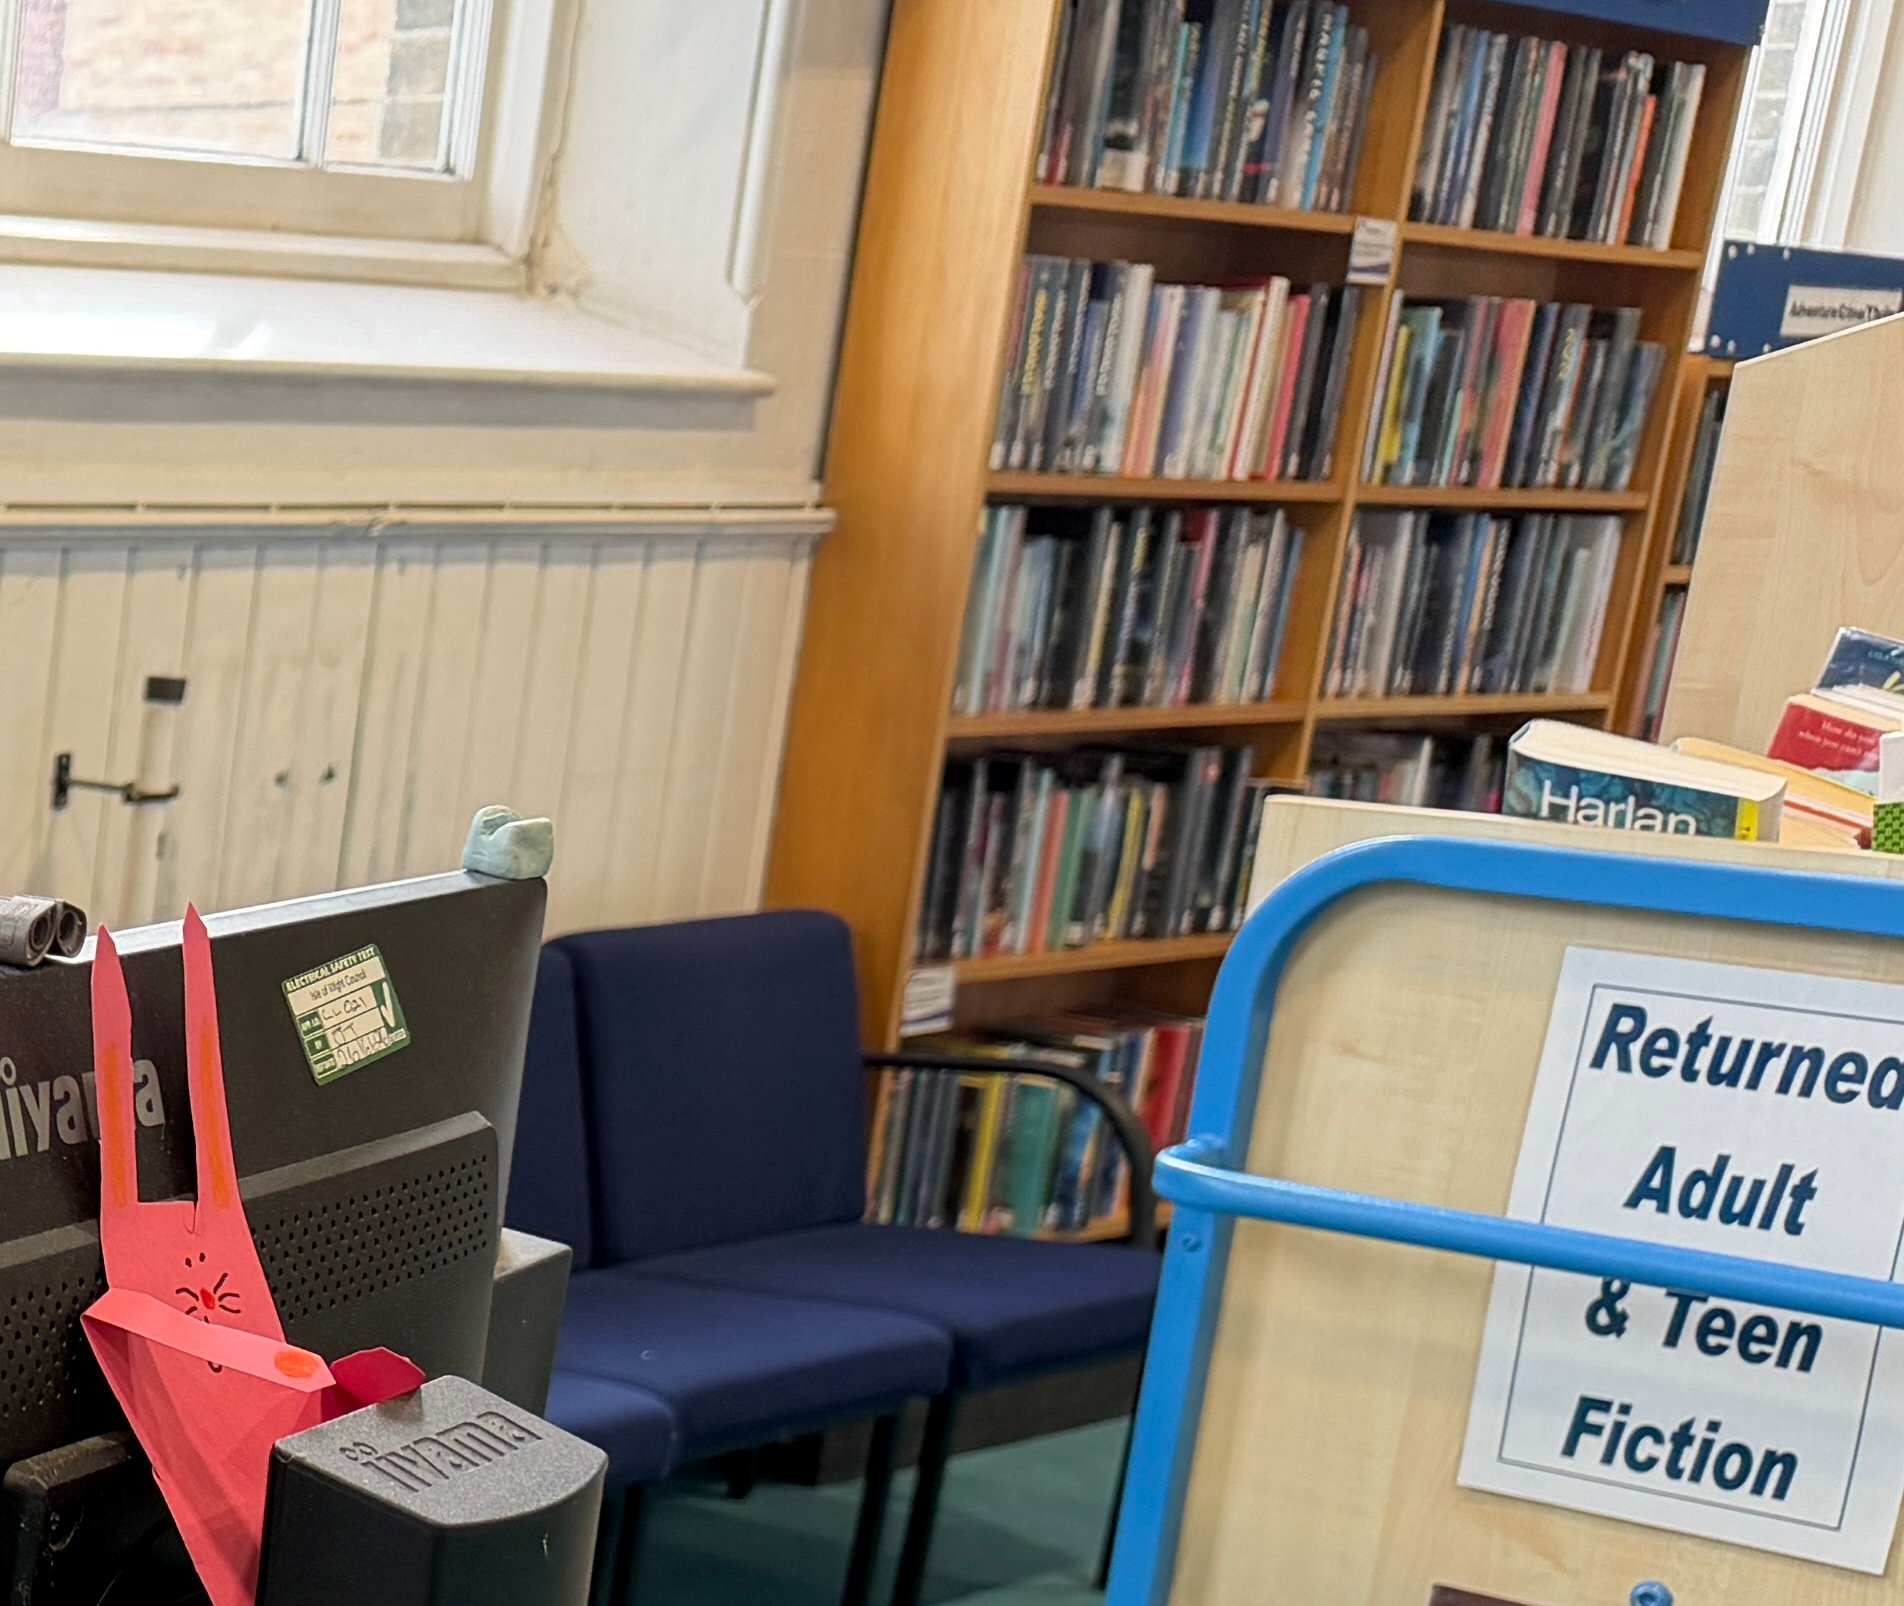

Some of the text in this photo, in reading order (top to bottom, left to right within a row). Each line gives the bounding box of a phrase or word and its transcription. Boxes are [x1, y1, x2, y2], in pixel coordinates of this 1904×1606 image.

[1540, 779, 1697, 837] Harlan
[1622, 1145, 1819, 1236] Adult
[1584, 1276, 1824, 1375] & Teen
[340, 1409, 544, 1494] iiyama
[1561, 1393, 1800, 1502] Fiction
